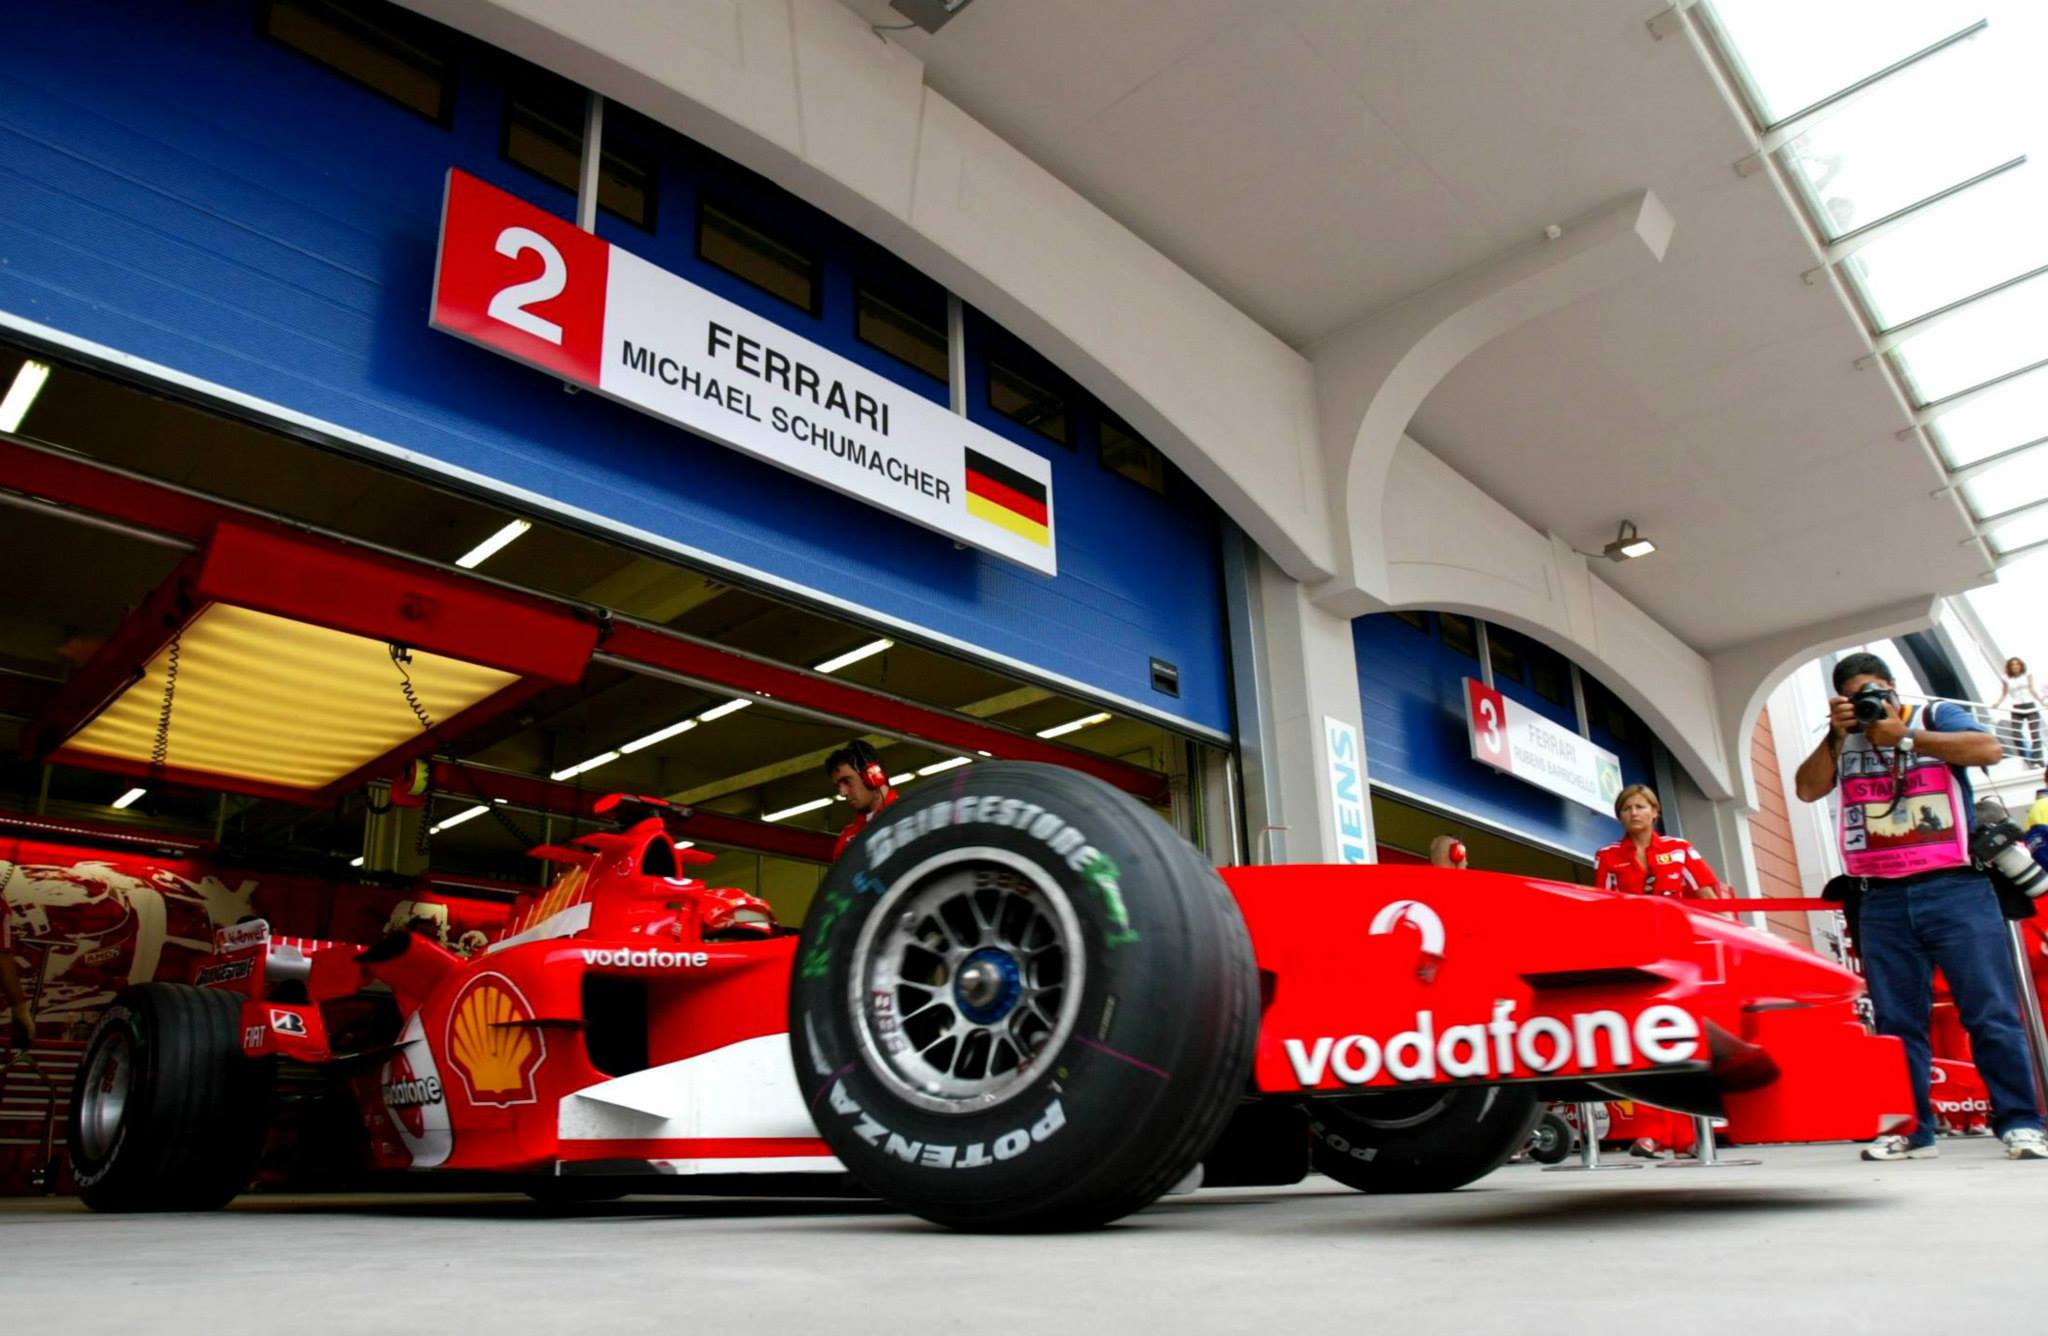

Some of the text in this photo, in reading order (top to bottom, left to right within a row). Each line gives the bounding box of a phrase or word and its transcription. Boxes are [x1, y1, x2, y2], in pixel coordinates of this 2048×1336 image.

[487, 226, 567, 345] 2
[707, 321, 889, 436] FERRARI
[621, 339, 951, 504] MICHAEL SCHUMACHER
[1480, 698, 1501, 755] 3
[1528, 723, 1577, 764] FERRARI
[581, 947, 709, 968] vodafone
[243, 1025, 266, 1049] FIAT
[1284, 999, 1700, 1086] vodafone
[830, 1079, 1067, 1169] POTENZA
[1936, 1097, 1992, 1113] voda
